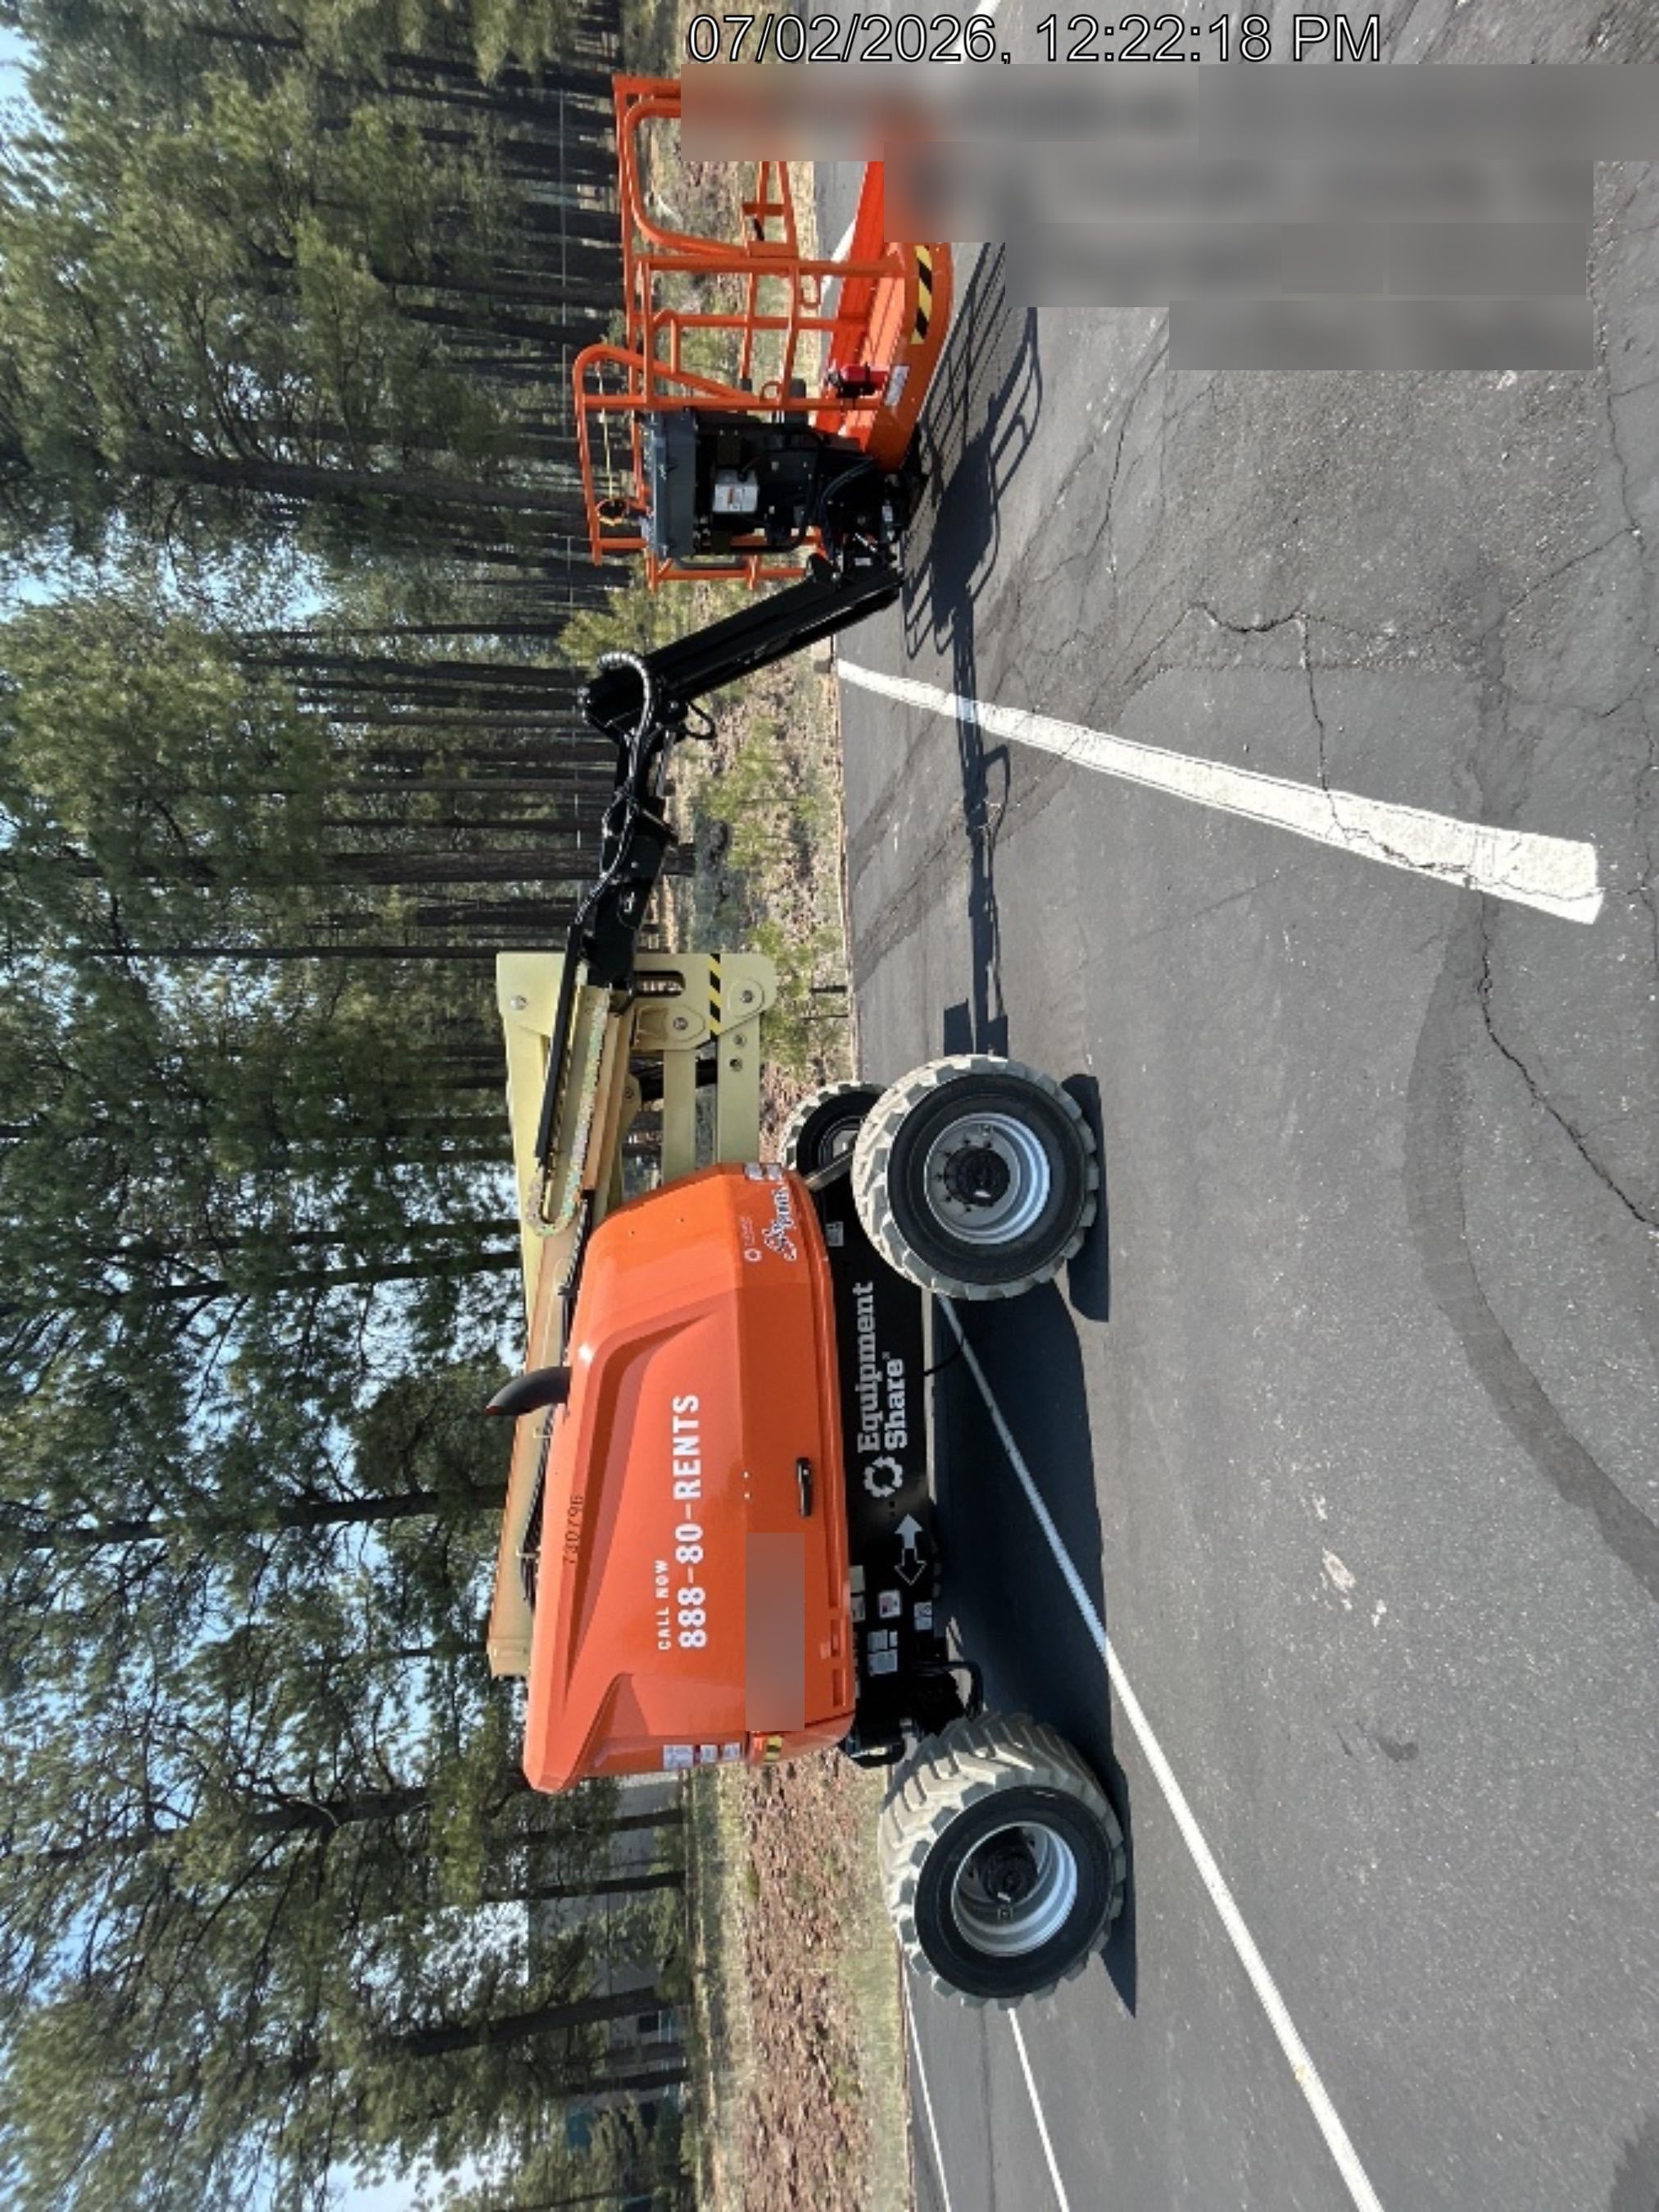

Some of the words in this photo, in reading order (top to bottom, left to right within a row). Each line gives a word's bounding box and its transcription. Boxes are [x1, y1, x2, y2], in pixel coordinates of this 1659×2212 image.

[852, 1281, 883, 1453] Equipment
[673, 1394, 707, 1648] 888-80-RENTS
[655, 1560, 669, 1598] NOW
[656, 1607, 671, 1650] CALL
